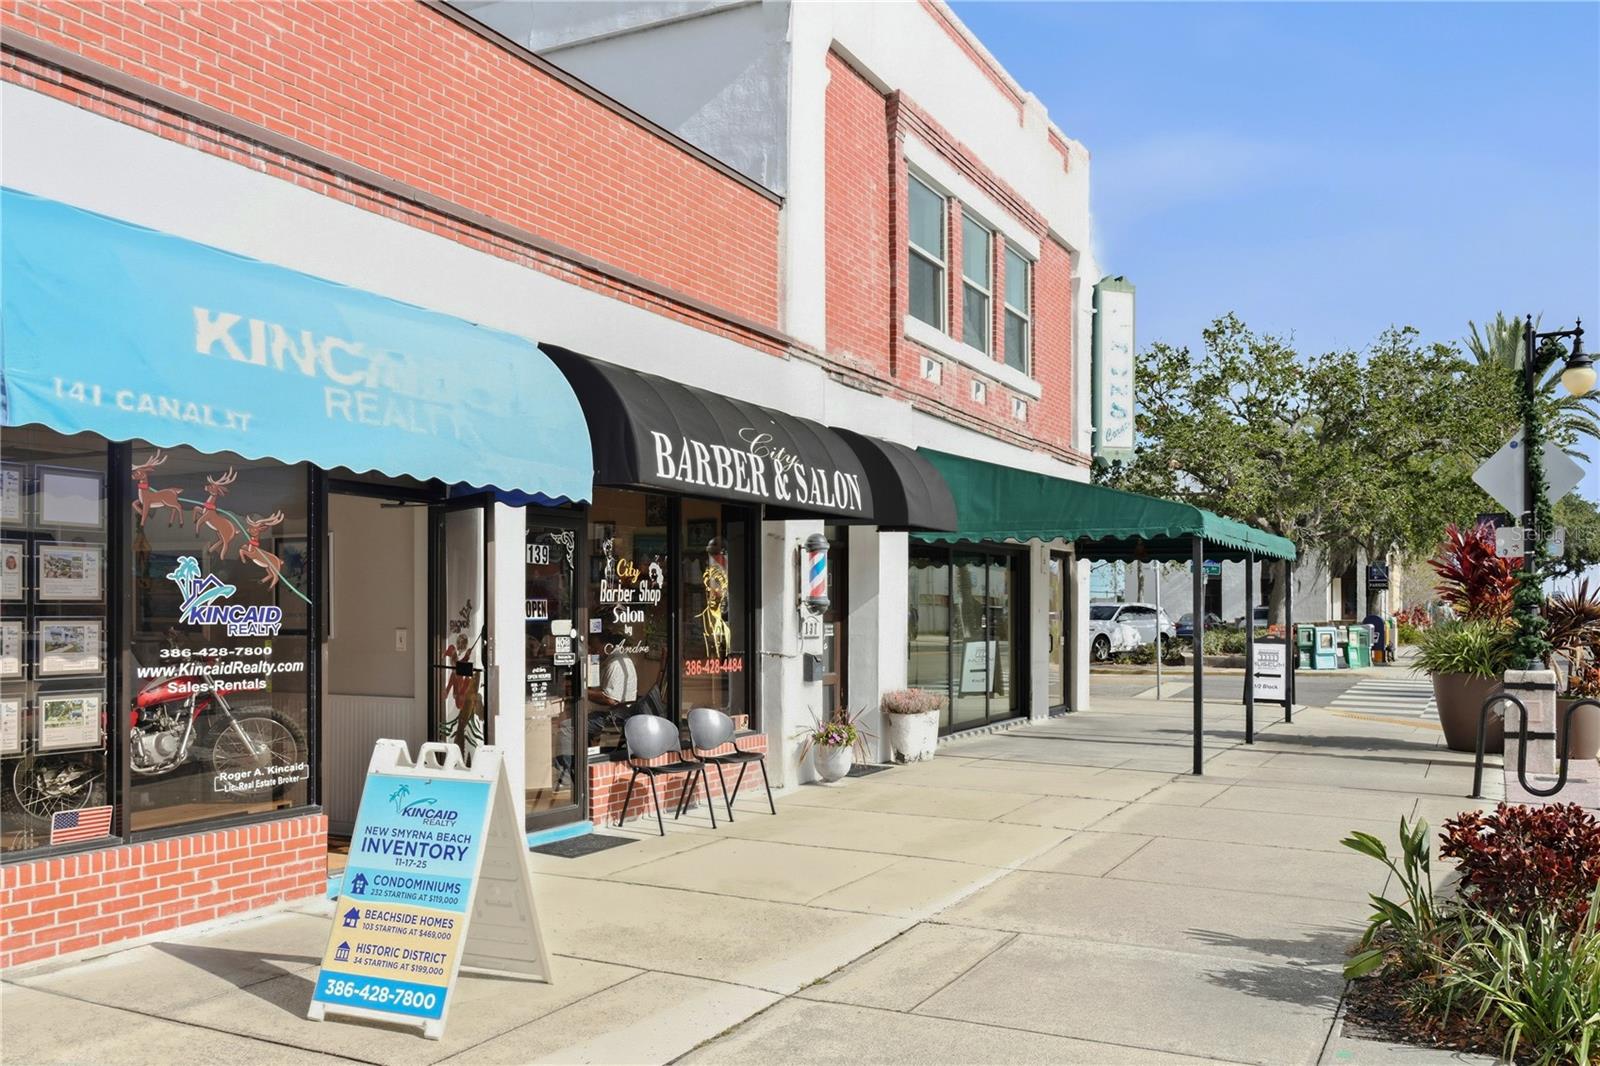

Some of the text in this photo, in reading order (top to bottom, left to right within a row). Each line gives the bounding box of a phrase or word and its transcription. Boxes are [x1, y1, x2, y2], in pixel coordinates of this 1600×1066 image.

[53, 376, 101, 407] 141
[115, 389, 216, 426] CANAL
[738, 428, 799, 471] City
[651, 430, 862, 512] BARBER & SALON
[528, 545, 548, 564] 139
[616, 558, 641, 583] City
[600, 579, 661, 606] Barber Shop
[187, 605, 282, 625] KINCAID
[525, 604, 548, 618] OPEN
[613, 606, 645, 623] Salon
[227, 623, 282, 636] REALTY
[624, 624, 633, 636] by
[160, 647, 273, 658] 386-428-7800
[604, 638, 650, 655] Andre
[137, 660, 304, 679] www.KincaidRealty.com
[685, 658, 743, 676] 386-428-4484
[167, 678, 267, 694] Sales-Rentals
[220, 762, 304, 782] Roger A. Kincaid
[238, 781, 255, 791] Real
[256, 779, 276, 788] Estate
[277, 775, 300, 785] Broker
[401, 807, 458, 820] KINCAID
[422, 818, 457, 828] REALTY
[364, 826, 472, 844] NEW SMYRNA BEACH
[361, 837, 469, 862] INVENTORY
[395, 858, 427, 869] 11-17-25
[373, 874, 461, 894] CONDOMINIUMS
[370, 888, 382, 896] 232
[384, 889, 417, 900] STARTING
[428, 895, 459, 905] $119,000
[364, 909, 454, 929] BEACHSIDE HOMES
[362, 922, 374, 930] 103
[375, 924, 407, 935] STARTING
[419, 929, 452, 940] $469,000
[356, 943, 447, 965] HISTORIC DISTRICT
[353, 956, 363, 965] 34
[364, 958, 398, 970] STARTING
[410, 964, 444, 976] $199,000
[324, 978, 436, 1009] 386-428-7800
